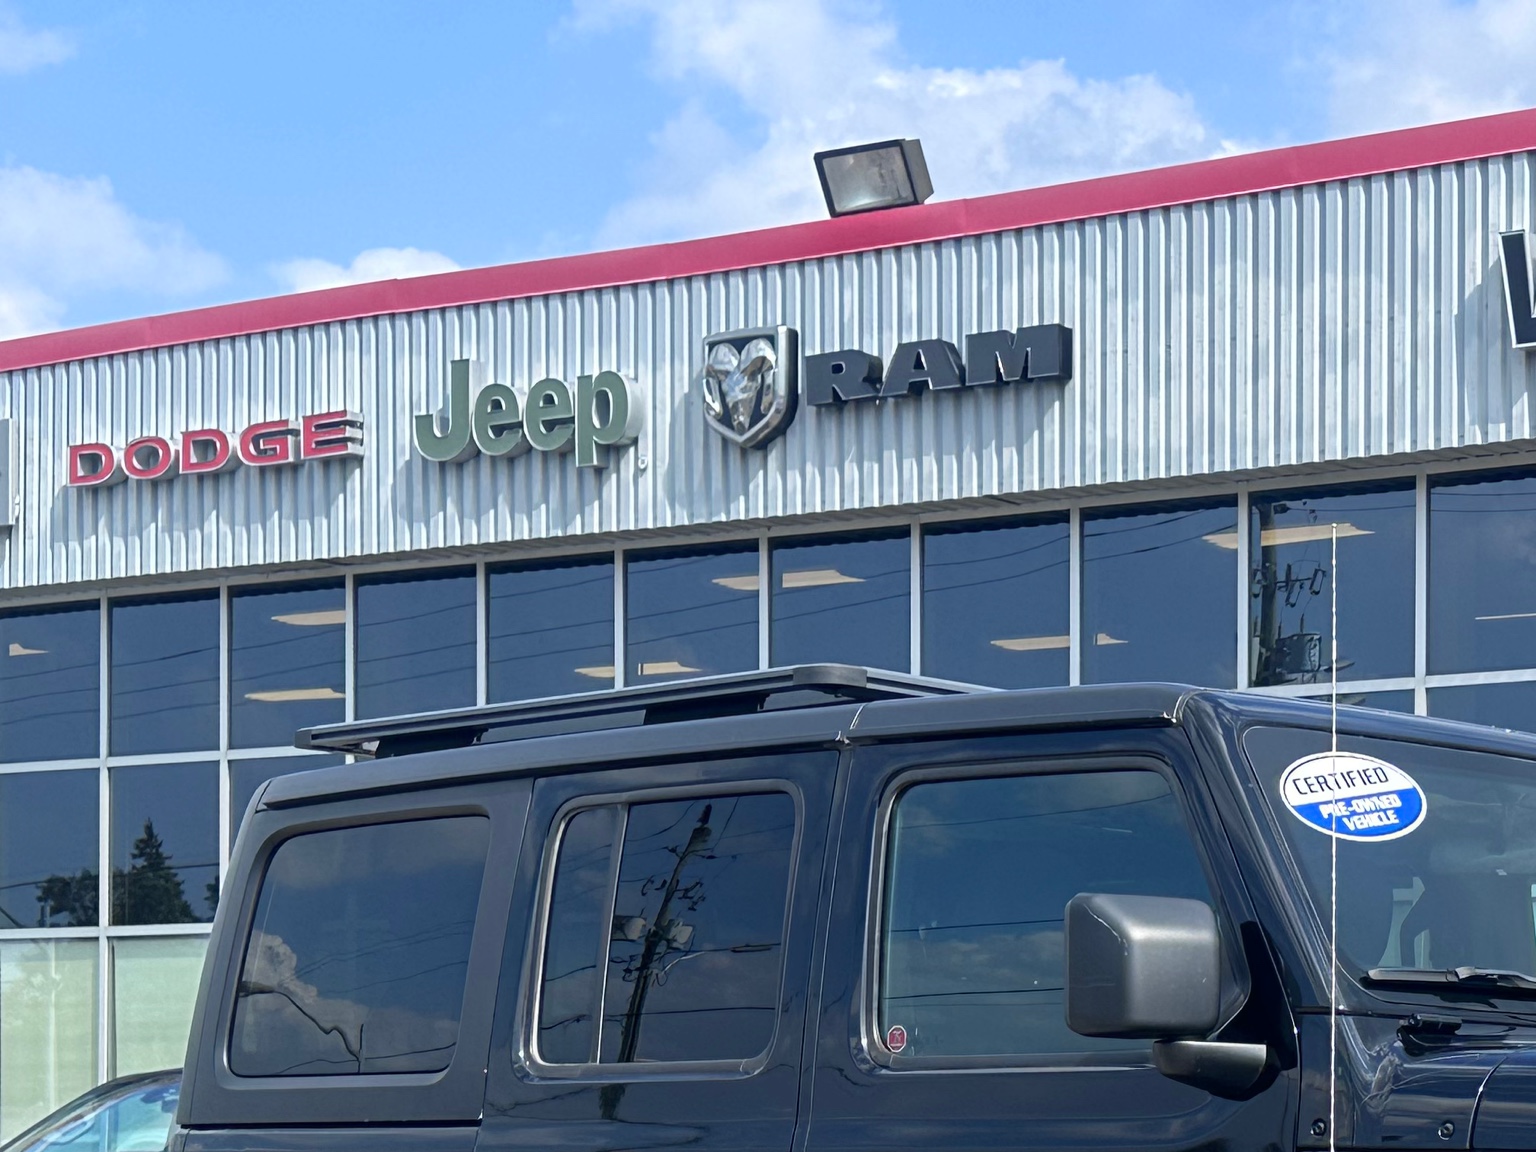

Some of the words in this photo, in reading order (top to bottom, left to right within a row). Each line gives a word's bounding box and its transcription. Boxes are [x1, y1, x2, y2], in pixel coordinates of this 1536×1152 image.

[805, 324, 1072, 407] RAM
[414, 358, 638, 468] Jeep
[67, 409, 362, 487] DODGE
[1292, 766, 1389, 795] CERTIFIED
[1318, 794, 1402, 819] PRE-OWNED
[1342, 810, 1400, 831] VEHICLE
